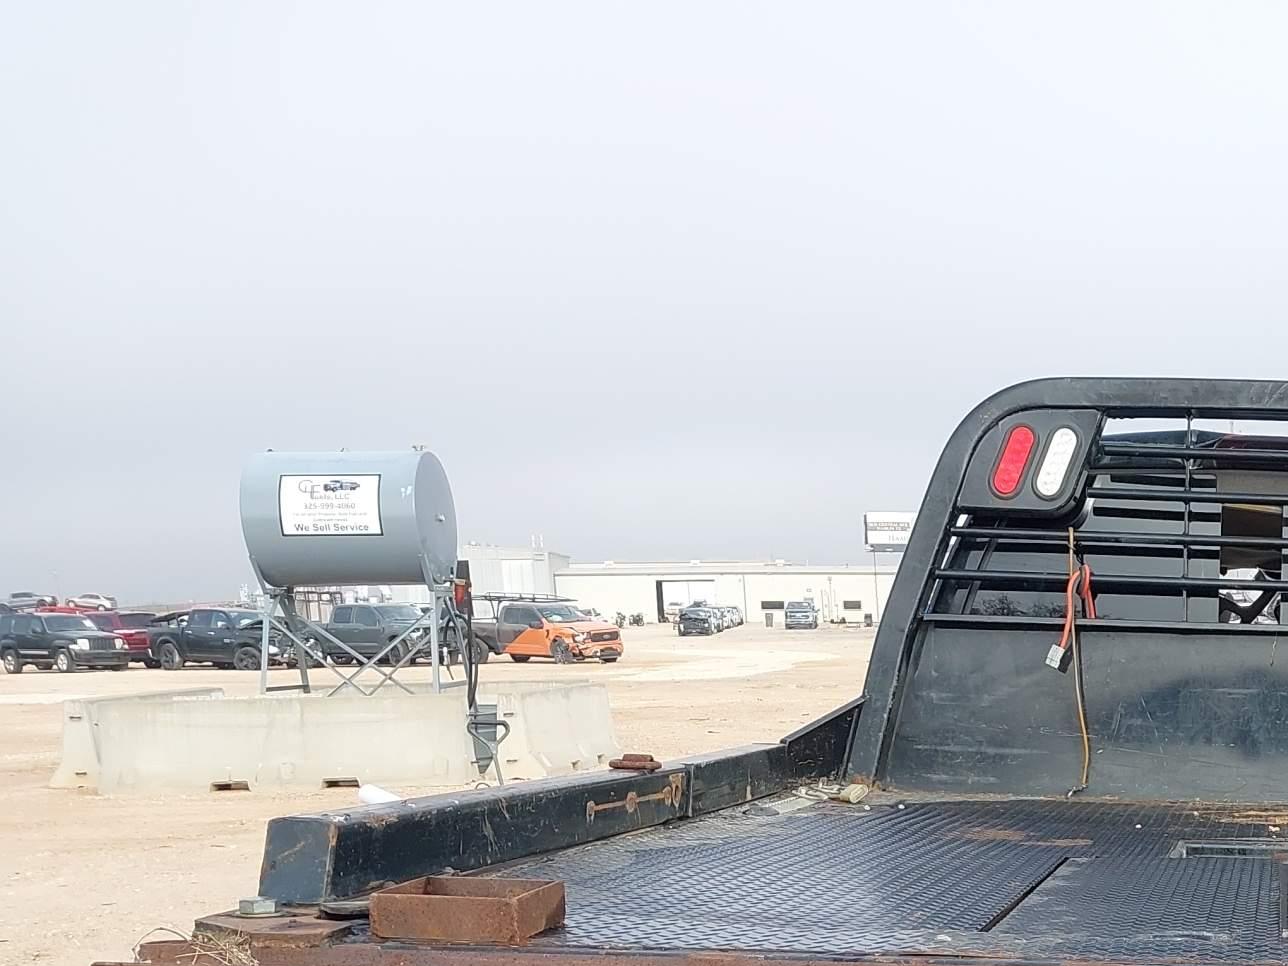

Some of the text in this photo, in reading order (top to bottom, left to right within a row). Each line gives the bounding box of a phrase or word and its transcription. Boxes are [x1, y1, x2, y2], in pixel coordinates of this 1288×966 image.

[294, 523, 370, 532] We Sell Service
